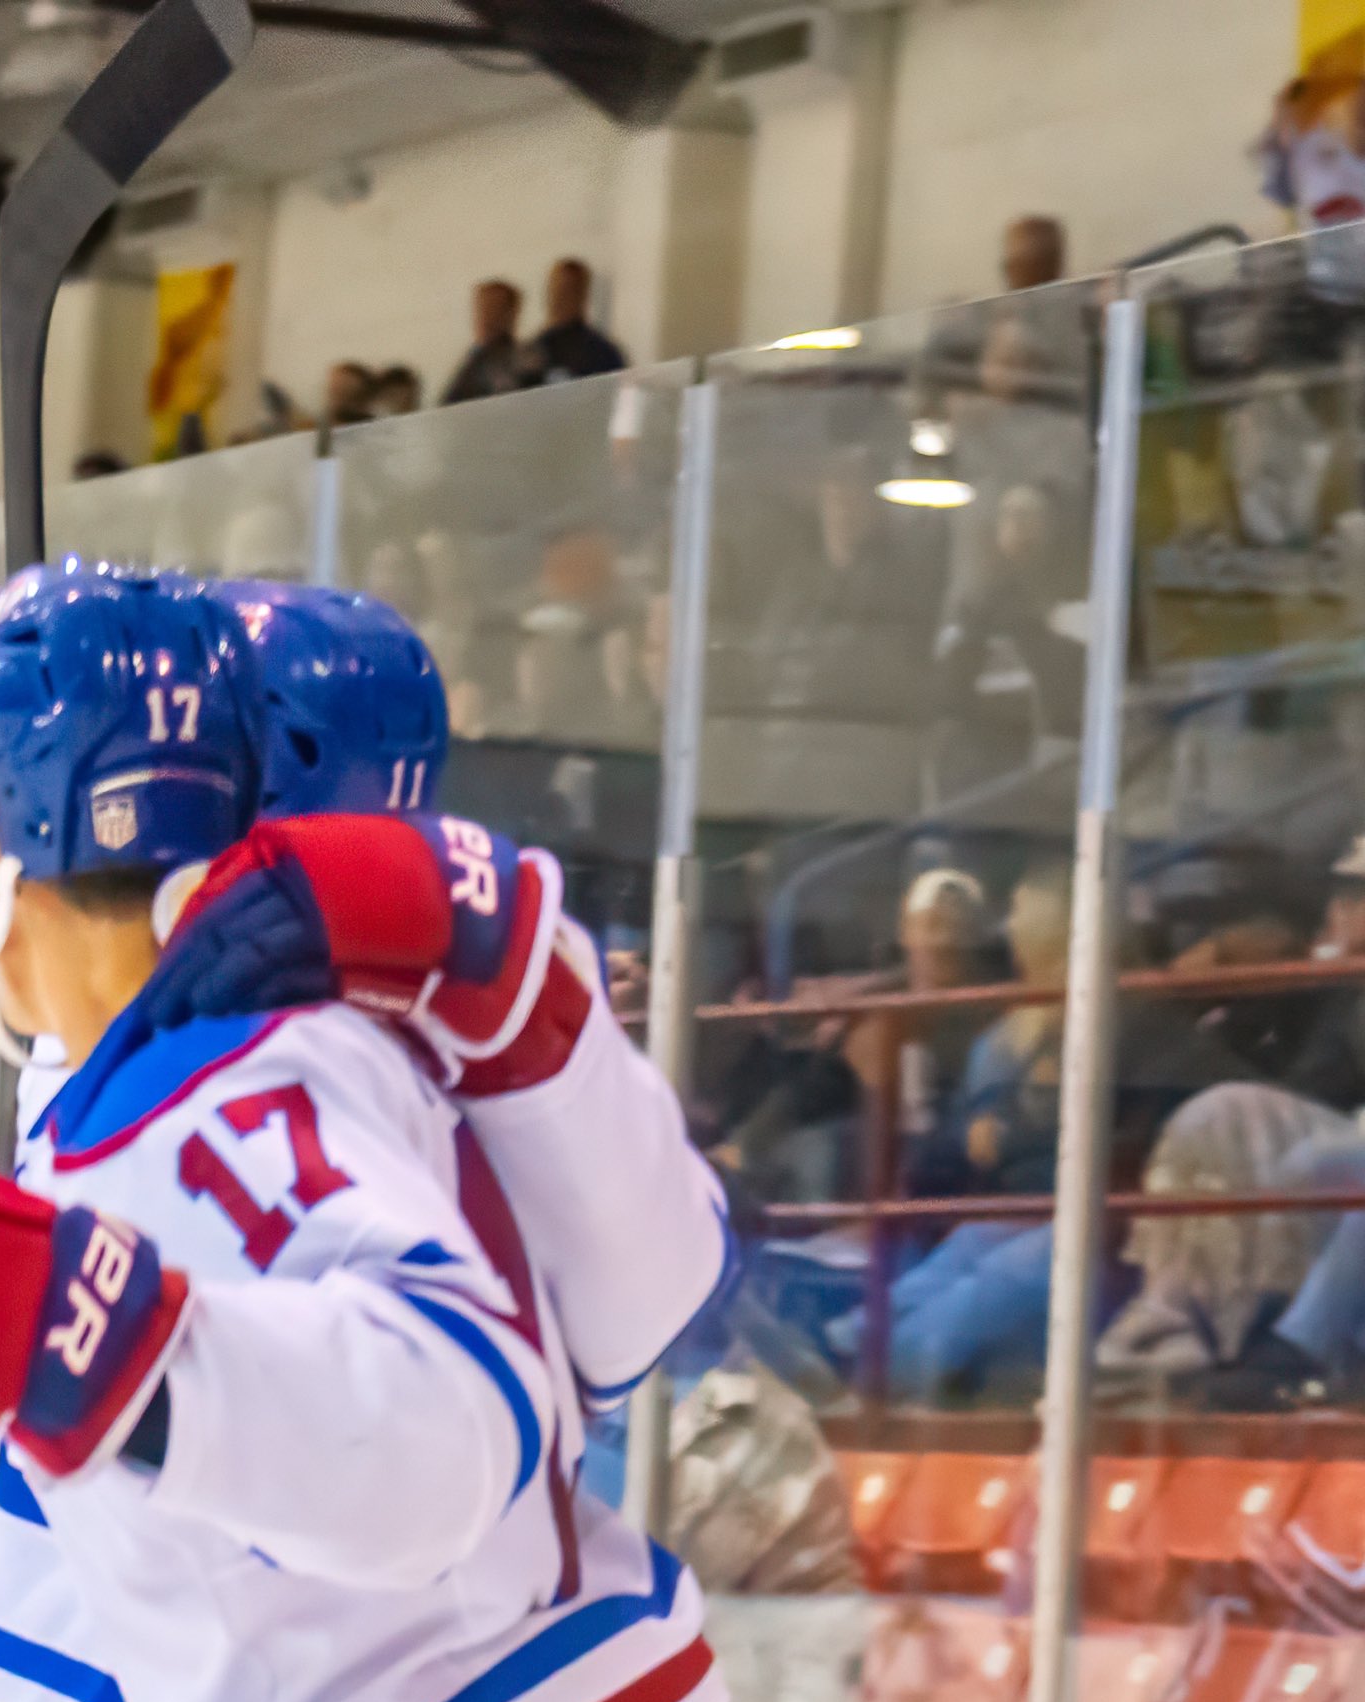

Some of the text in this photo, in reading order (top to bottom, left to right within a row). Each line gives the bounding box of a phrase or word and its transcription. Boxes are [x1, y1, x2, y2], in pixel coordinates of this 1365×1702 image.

[145, 686, 201, 743] 17
[386, 758, 427, 811] 11
[177, 1080, 359, 1278] 17
